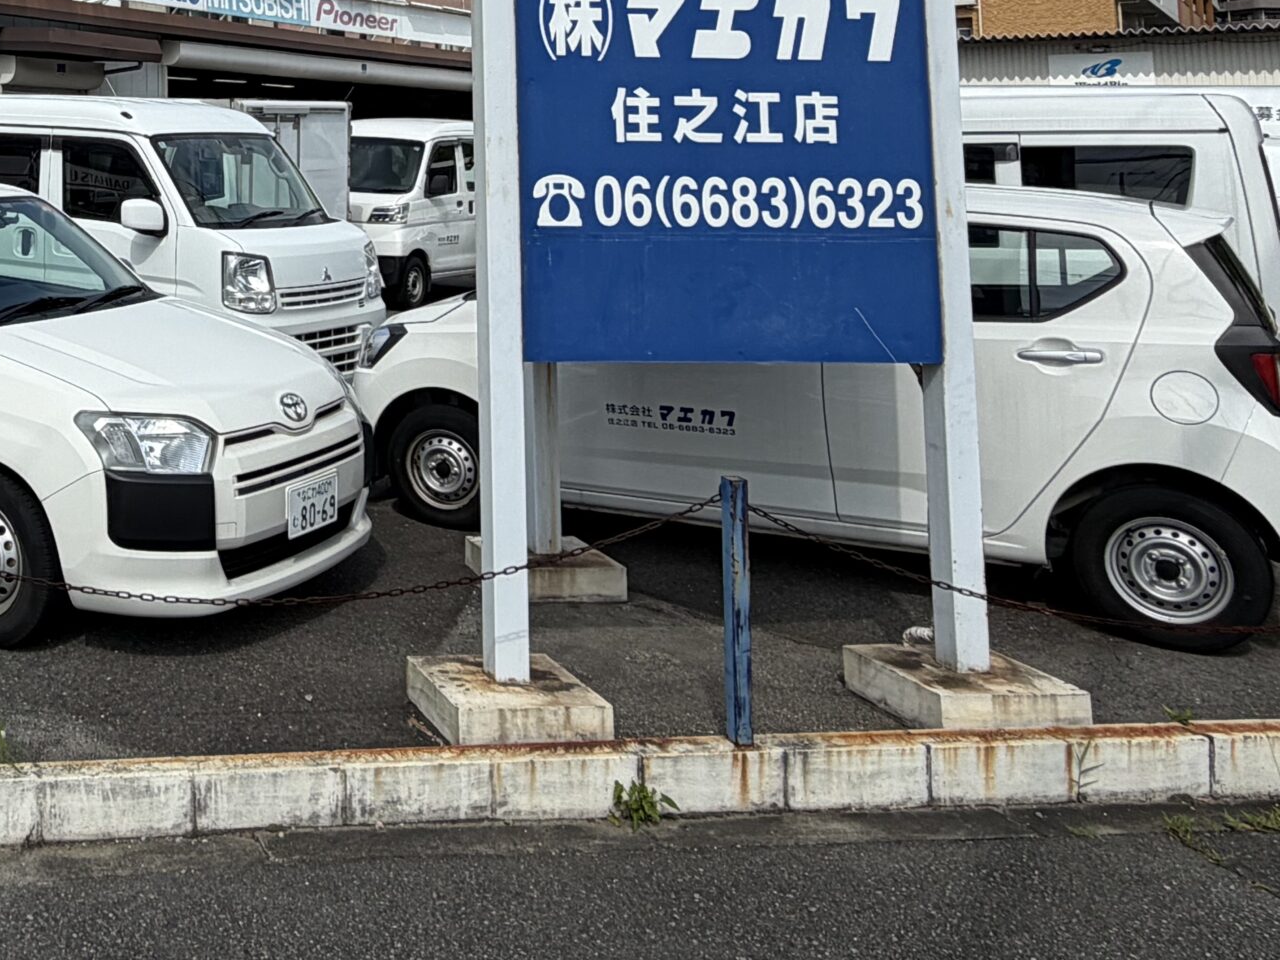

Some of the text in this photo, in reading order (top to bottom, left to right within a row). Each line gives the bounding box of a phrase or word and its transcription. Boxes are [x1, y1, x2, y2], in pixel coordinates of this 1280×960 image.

[611, 87, 838, 144] 住之江店
[593, 174, 924, 229] 06(6683)6323
[606, 403, 735, 427] 株式会社 マエカワ
[641, 421, 658, 429] TEL
[301, 495, 336, 530] 80-69
